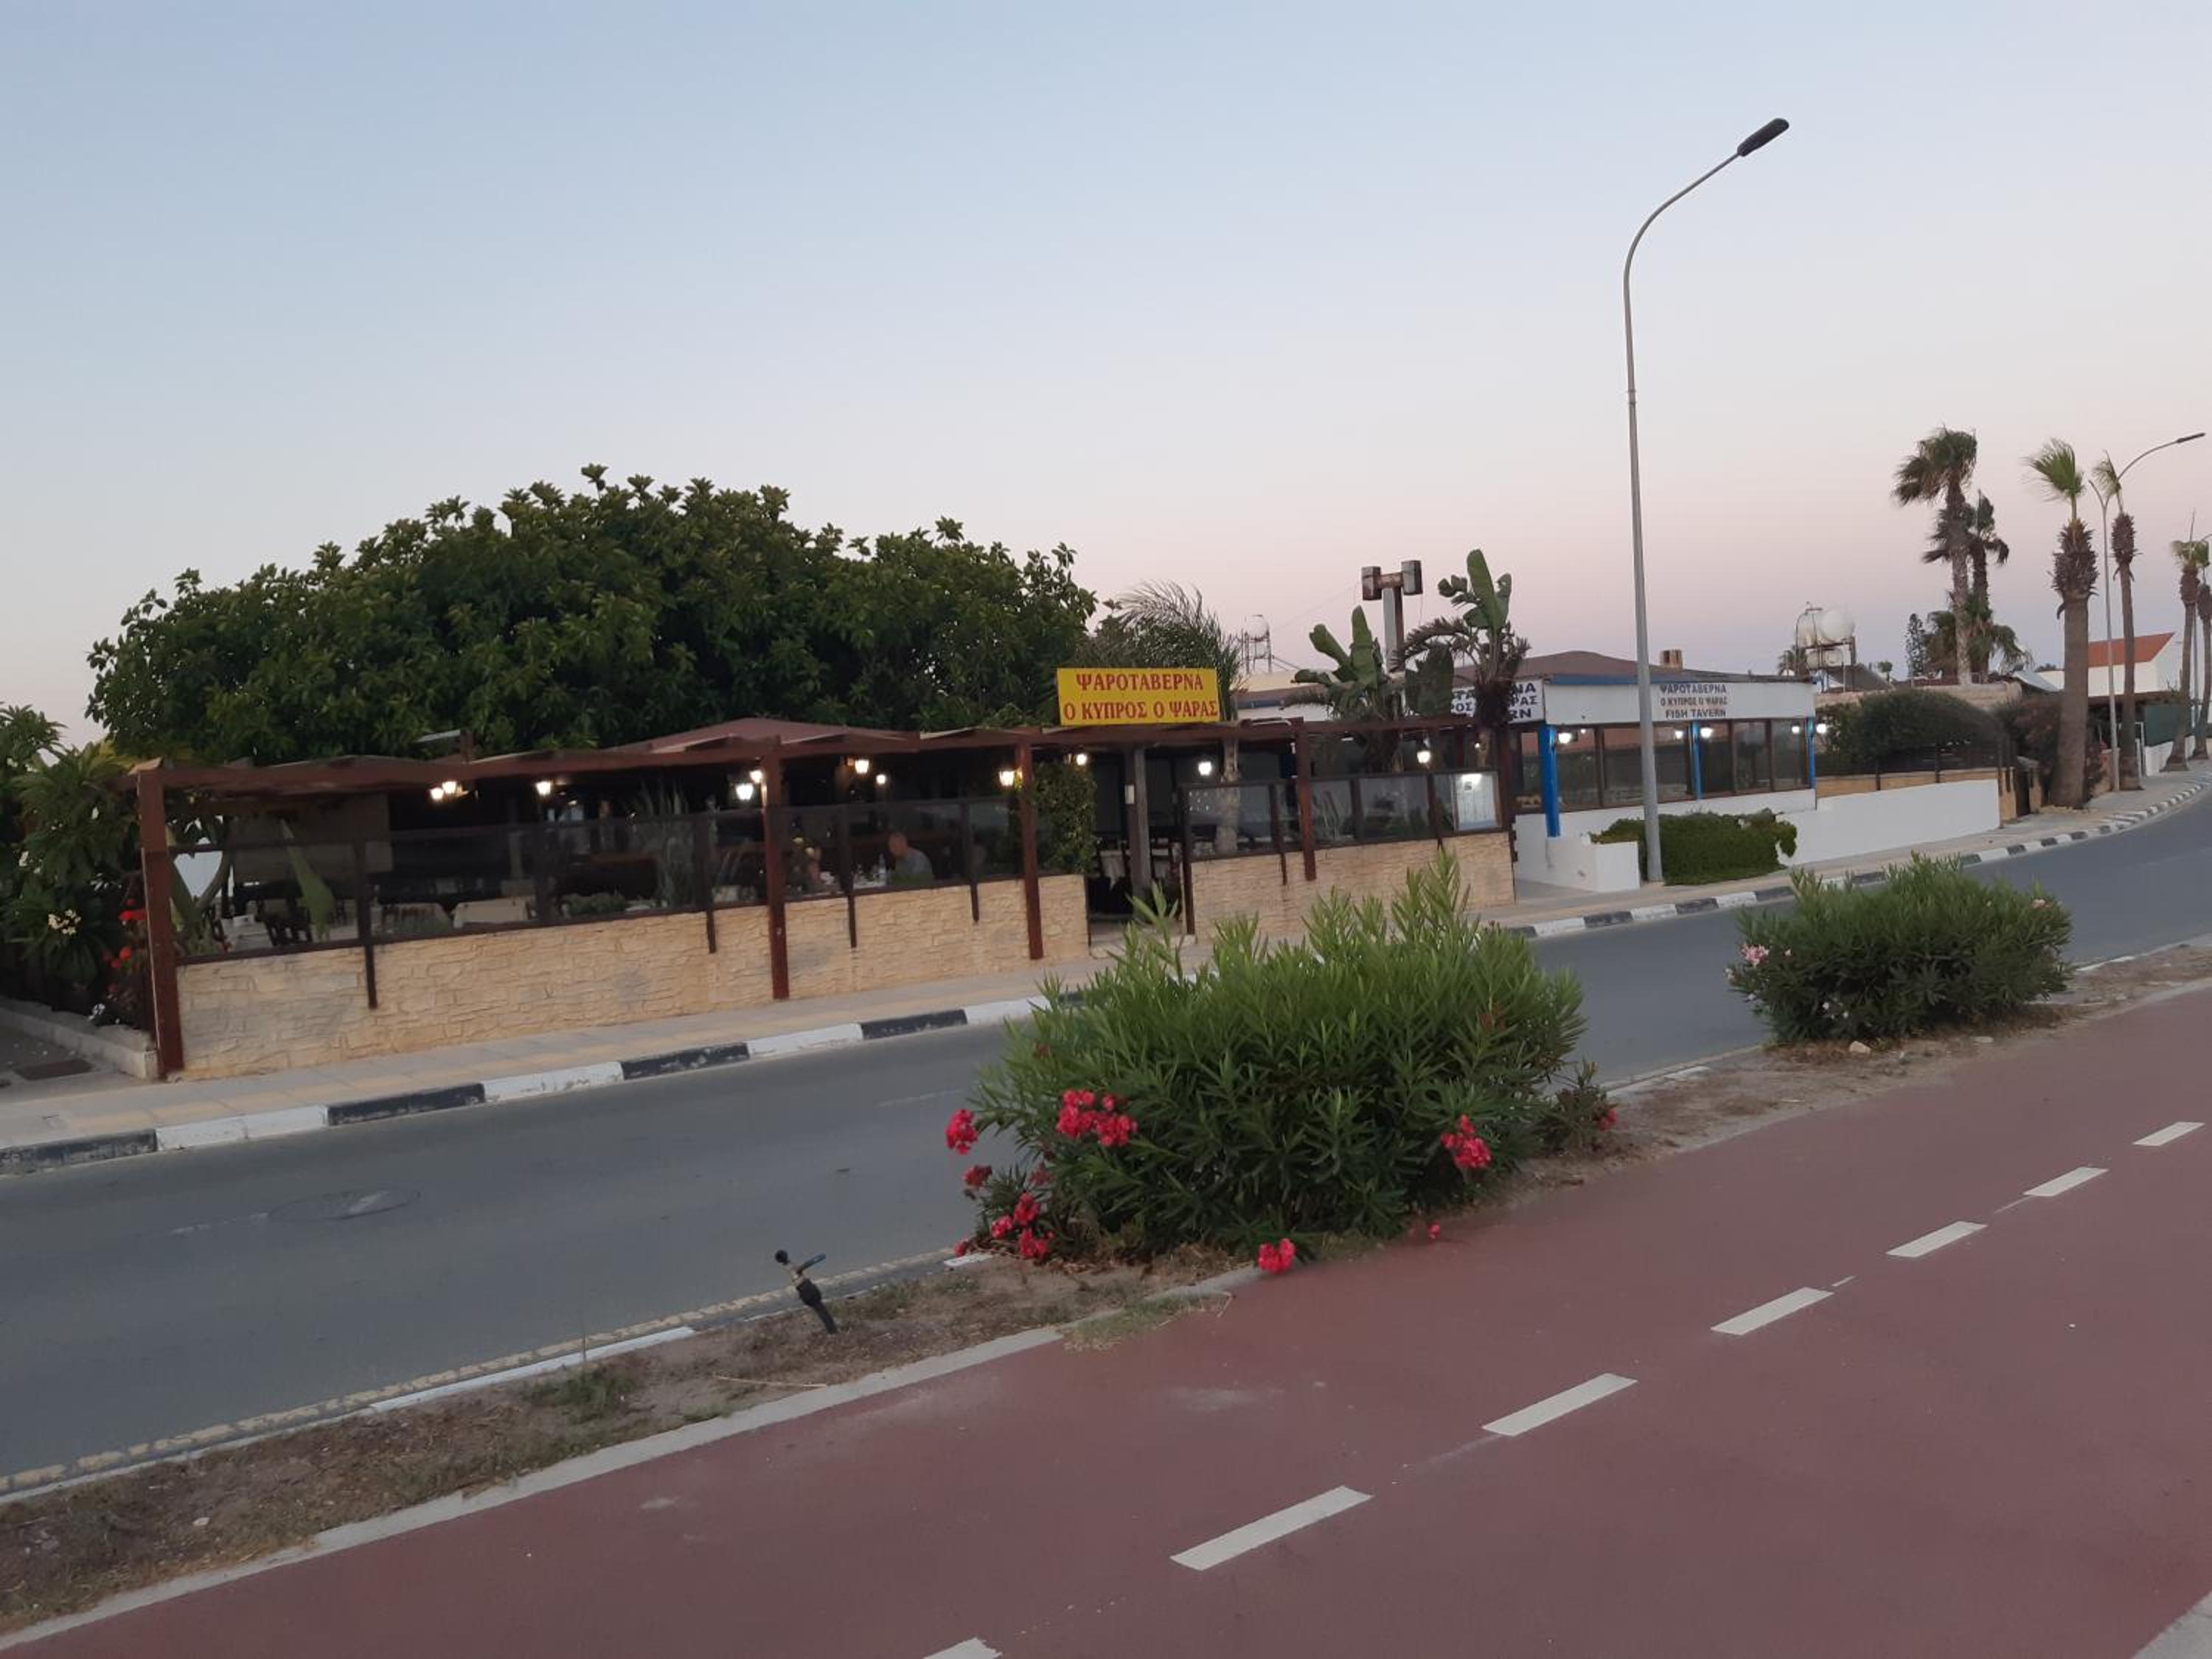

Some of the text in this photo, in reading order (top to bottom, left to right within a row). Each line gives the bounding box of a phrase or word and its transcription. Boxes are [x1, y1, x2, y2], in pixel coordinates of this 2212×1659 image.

[1077, 673, 1203, 691] ΨΑΡΟΤΑΒΕΡΝΑ
[1064, 700, 1217, 720] Ο ΚΥΠΡΟΣ Ο ΨΑΡΑΣ
[1666, 708, 1726, 718] FISH TAVERN
